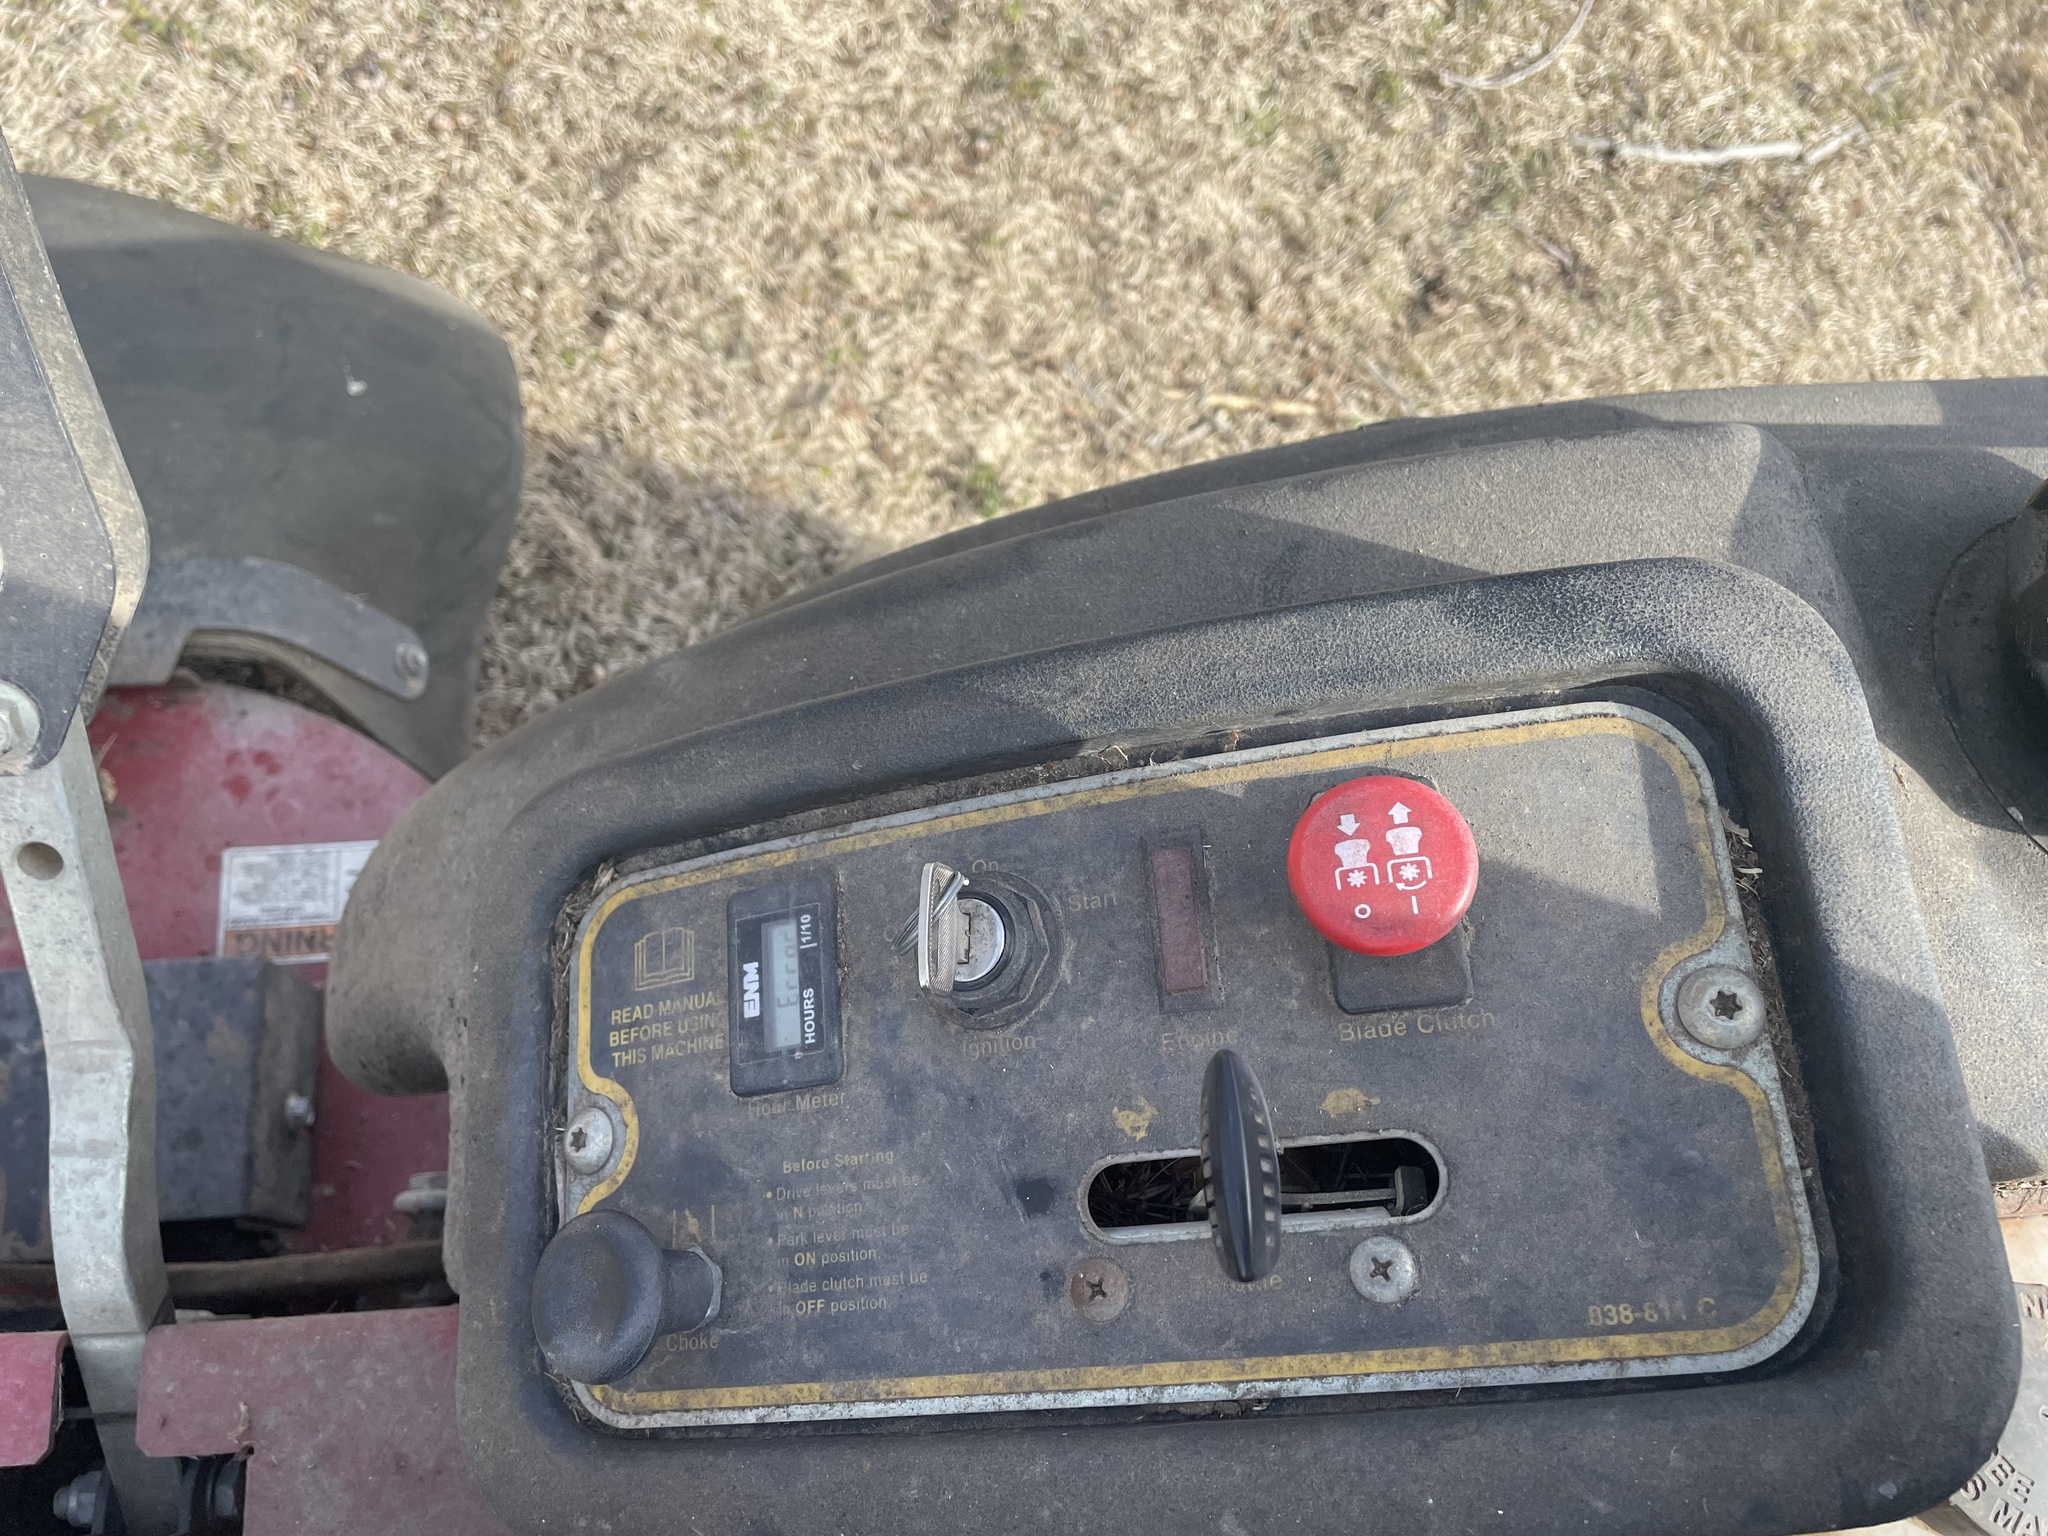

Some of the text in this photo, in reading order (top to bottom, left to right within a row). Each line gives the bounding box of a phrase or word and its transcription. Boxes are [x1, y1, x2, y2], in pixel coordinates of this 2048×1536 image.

[743, 961, 760, 1019] ENM
[611, 989, 722, 1026] READ MANUA
[802, 987, 816, 1044] HOURS
[609, 1021, 673, 1048] BEFORE
[1338, 1008, 1496, 1042] Blade Clutch
[611, 1033, 725, 1068] THIS MACHINE
[962, 1035, 1038, 1061] Ignition
[795, 1091, 847, 1111] Meter
[782, 1150, 895, 1174] Before Starting
[776, 1186, 812, 1201] Drive
[792, 1206, 804, 1219] N
[777, 1231, 808, 1248] Park
[852, 1224, 887, 1240] must
[794, 1251, 817, 1267] ON
[822, 1274, 865, 1292] clutch
[869, 1270, 905, 1288] must
[909, 1271, 929, 1284] be
[795, 1298, 827, 1315] OFF
[666, 1331, 719, 1352] Choke
